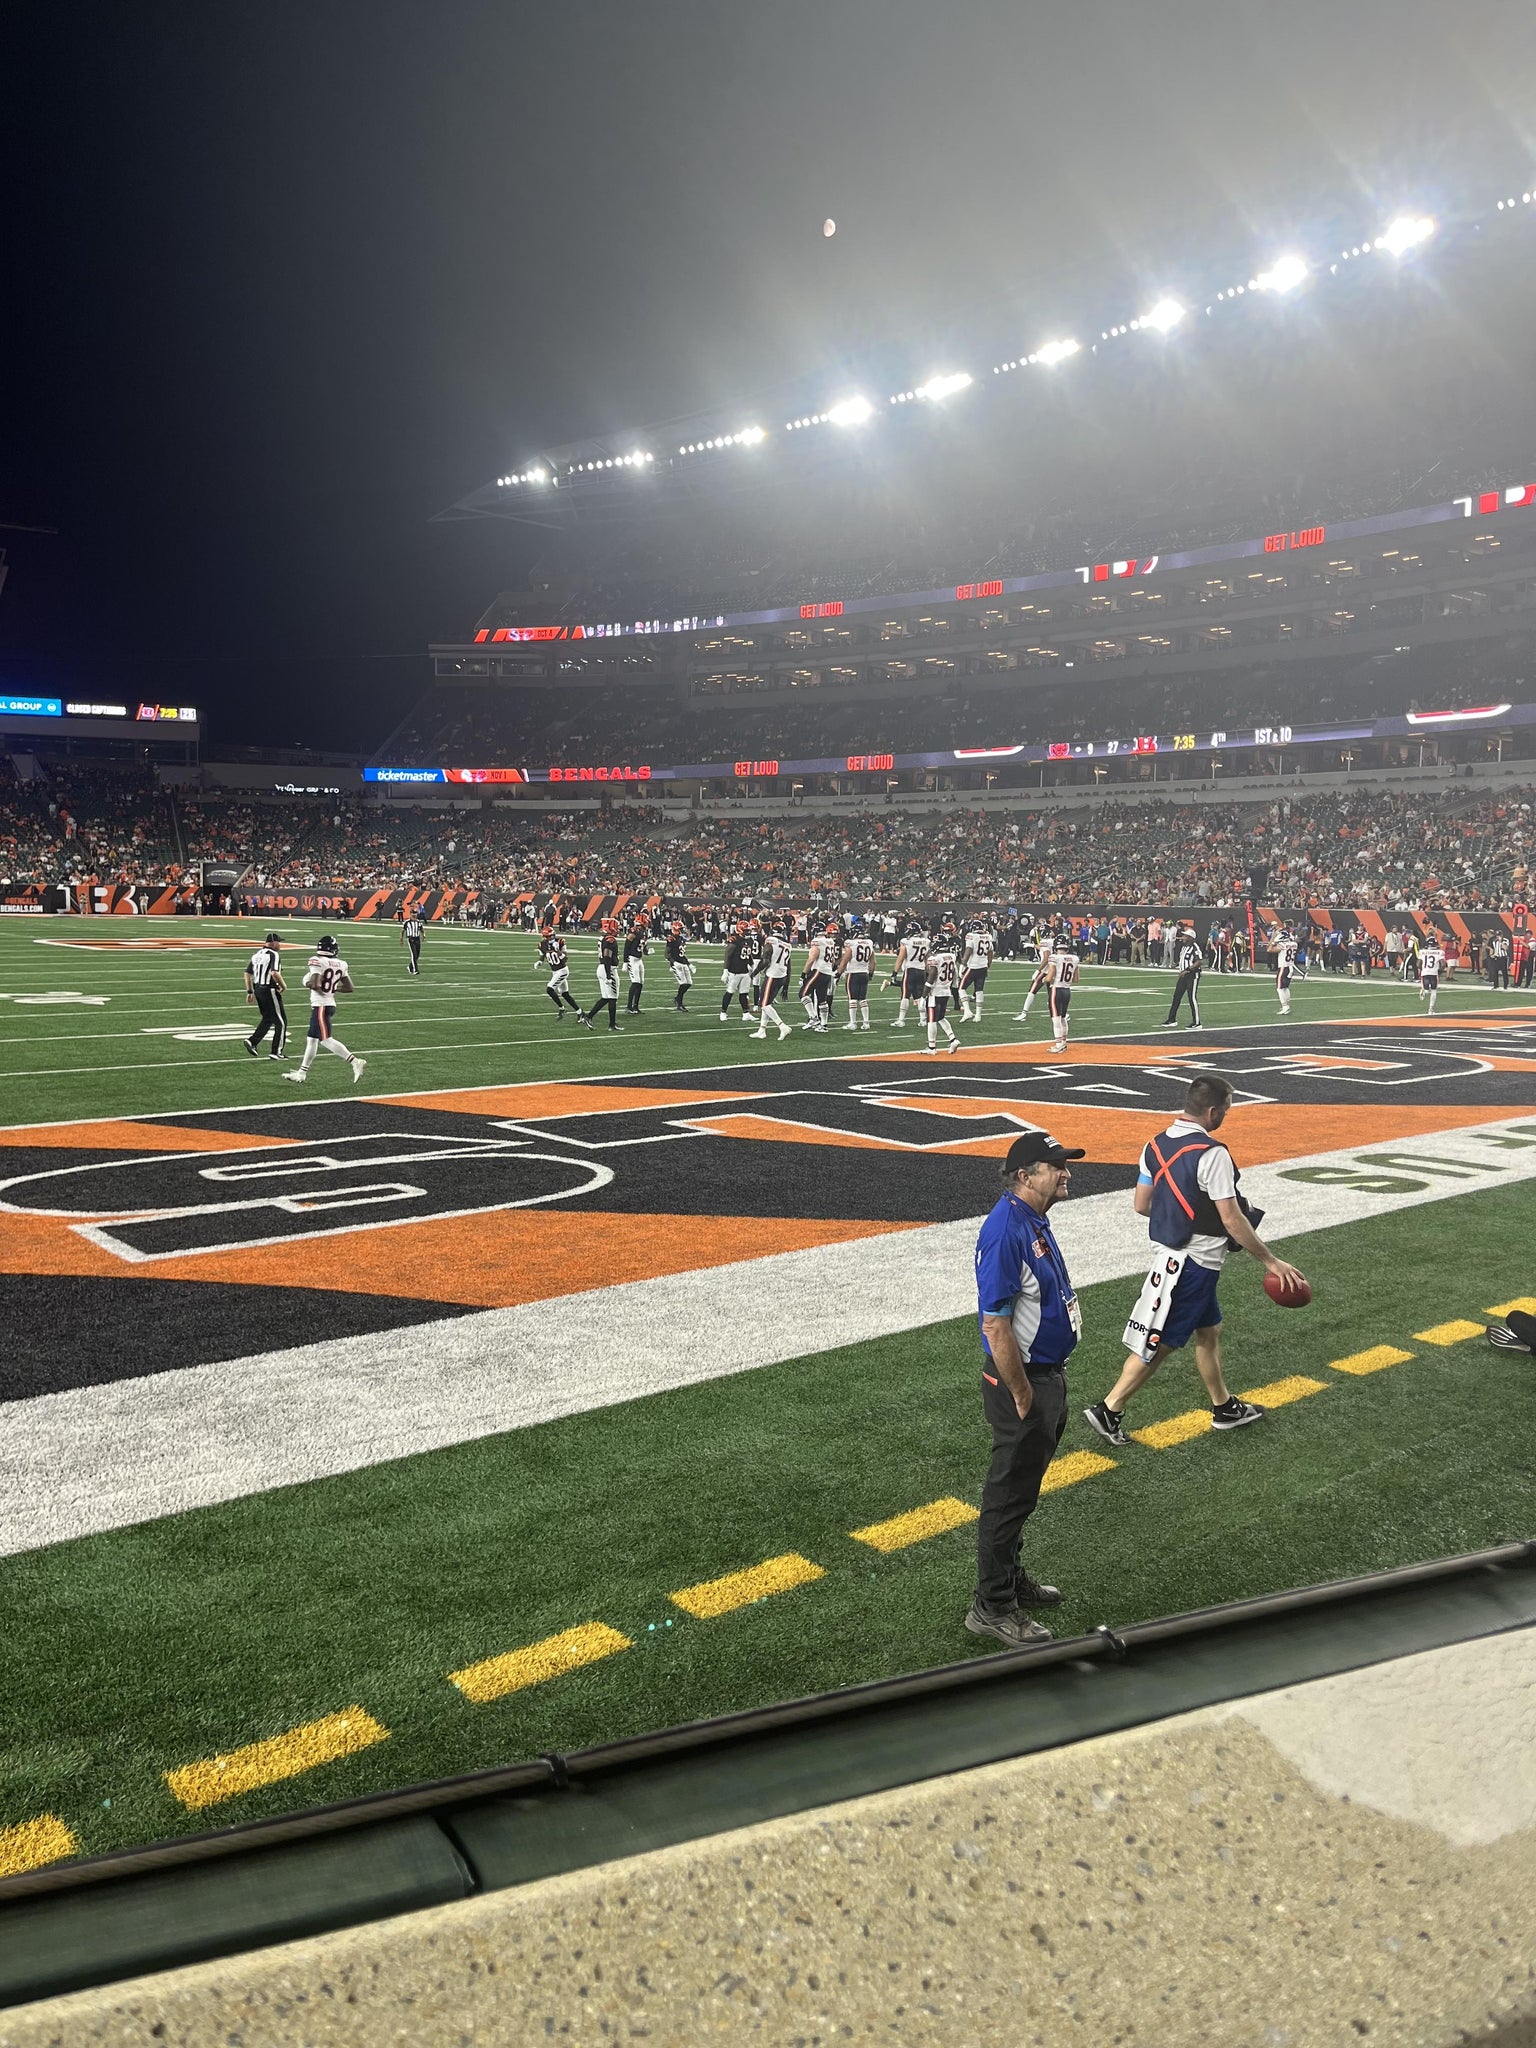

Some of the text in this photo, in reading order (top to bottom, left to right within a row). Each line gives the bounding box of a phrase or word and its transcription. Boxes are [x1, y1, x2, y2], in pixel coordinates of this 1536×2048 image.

[1264, 527, 1325, 553] GET LOUD
[956, 580, 1003, 599] GET LOUD
[800, 601, 843, 619] GET LOUD
[10, 702, 42, 710] GROUP
[1173, 735, 1195, 750] 7:35
[1210, 731, 1227, 748] 4TH
[1255, 729, 1272, 744] 1ST
[1279, 727, 1292, 742] 10
[1087, 743, 1094, 755] 9
[1107, 741, 1119, 754] 27
[734, 760, 779, 776] GET LOUD
[847, 754, 894, 771] GET LOUD
[377, 769, 438, 781] ticketmaster
[549, 766, 651, 782] BENGALS
[775, 944, 791, 966] 72
[856, 944, 872, 963] 60
[909, 945, 927, 963] 76
[976, 940, 990, 956] 63
[545, 950, 561, 966] 40
[1424, 955, 1436, 969] 13
[939, 961, 955, 982] 38
[1060, 962, 1073, 982] 16
[321, 968, 343, 994] 82
